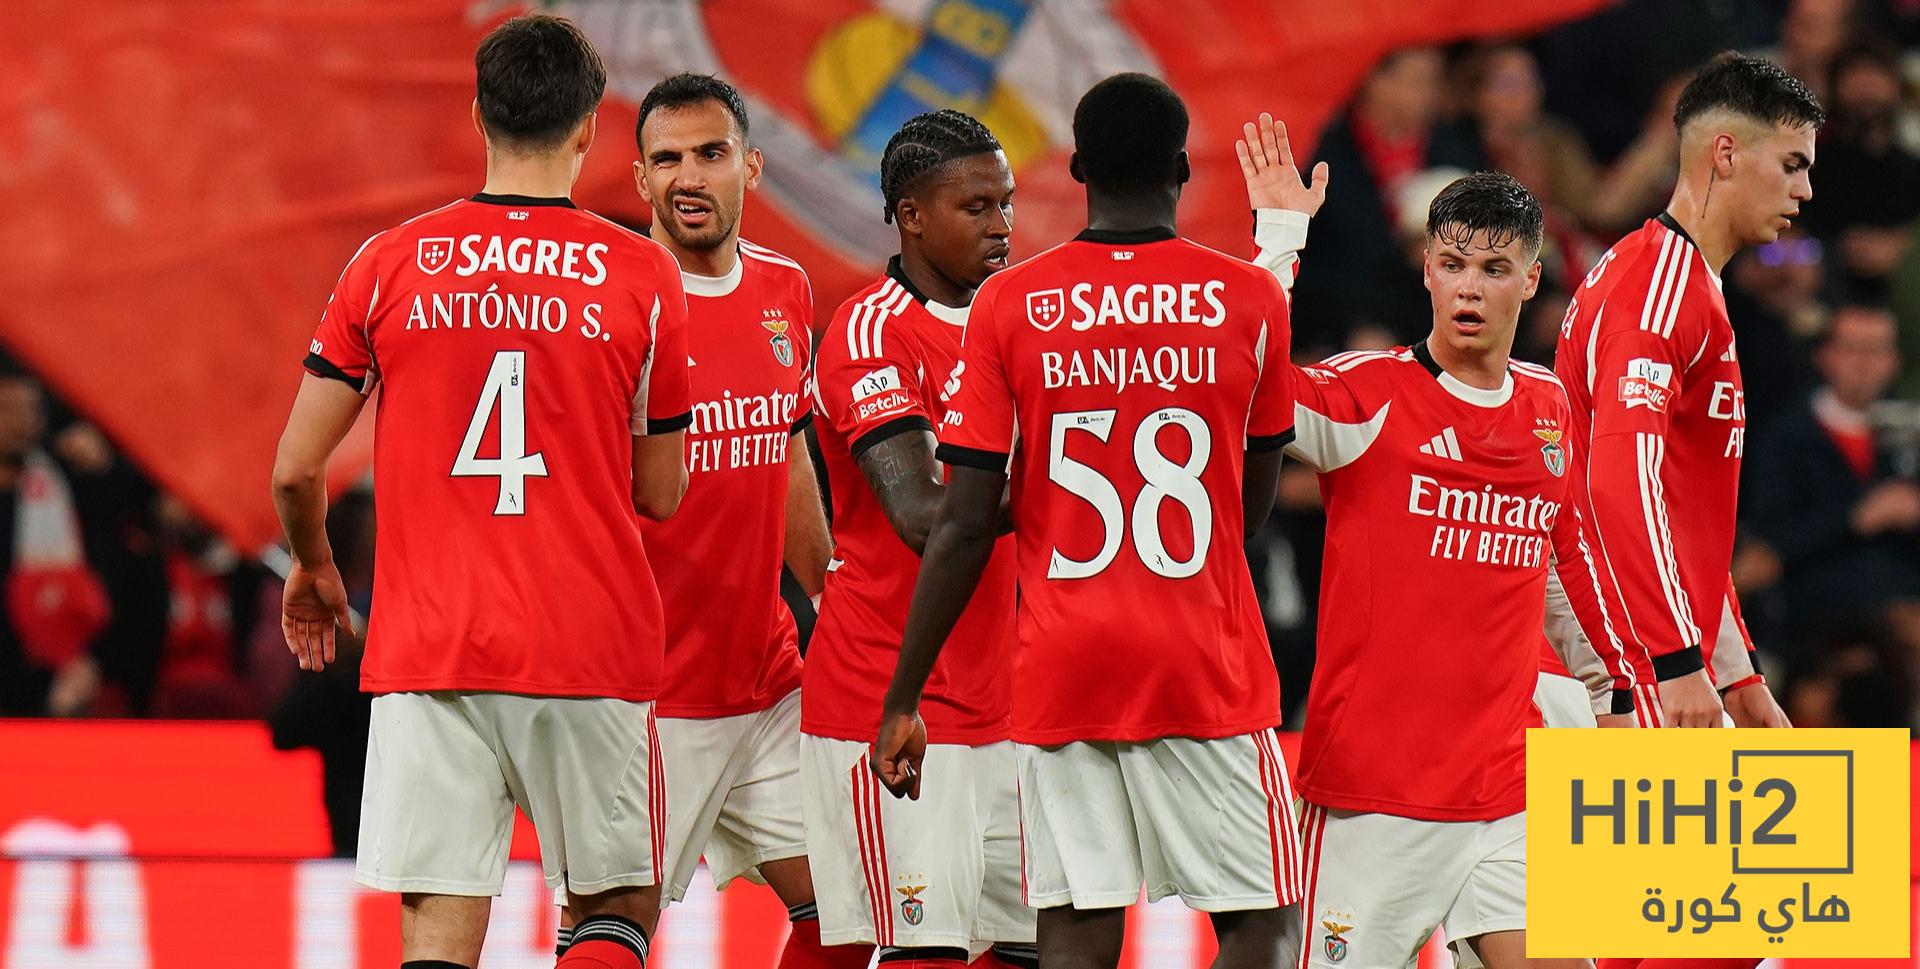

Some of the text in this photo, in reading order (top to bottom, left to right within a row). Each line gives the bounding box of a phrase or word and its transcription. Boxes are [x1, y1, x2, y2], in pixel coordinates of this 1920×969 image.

[455, 234, 609, 286] SAGRES
[405, 282, 611, 342] ANTÓNIO S.
[1070, 280, 1226, 331] SAGRES
[1041, 346, 1216, 394] BANJAQUI
[450, 350, 549, 516] 4
[689, 387, 799, 435] mirate
[689, 431, 788, 473] FLY BETTER
[1046, 407, 1213, 580] 58
[1430, 525, 1543, 568] FLY BETTER
